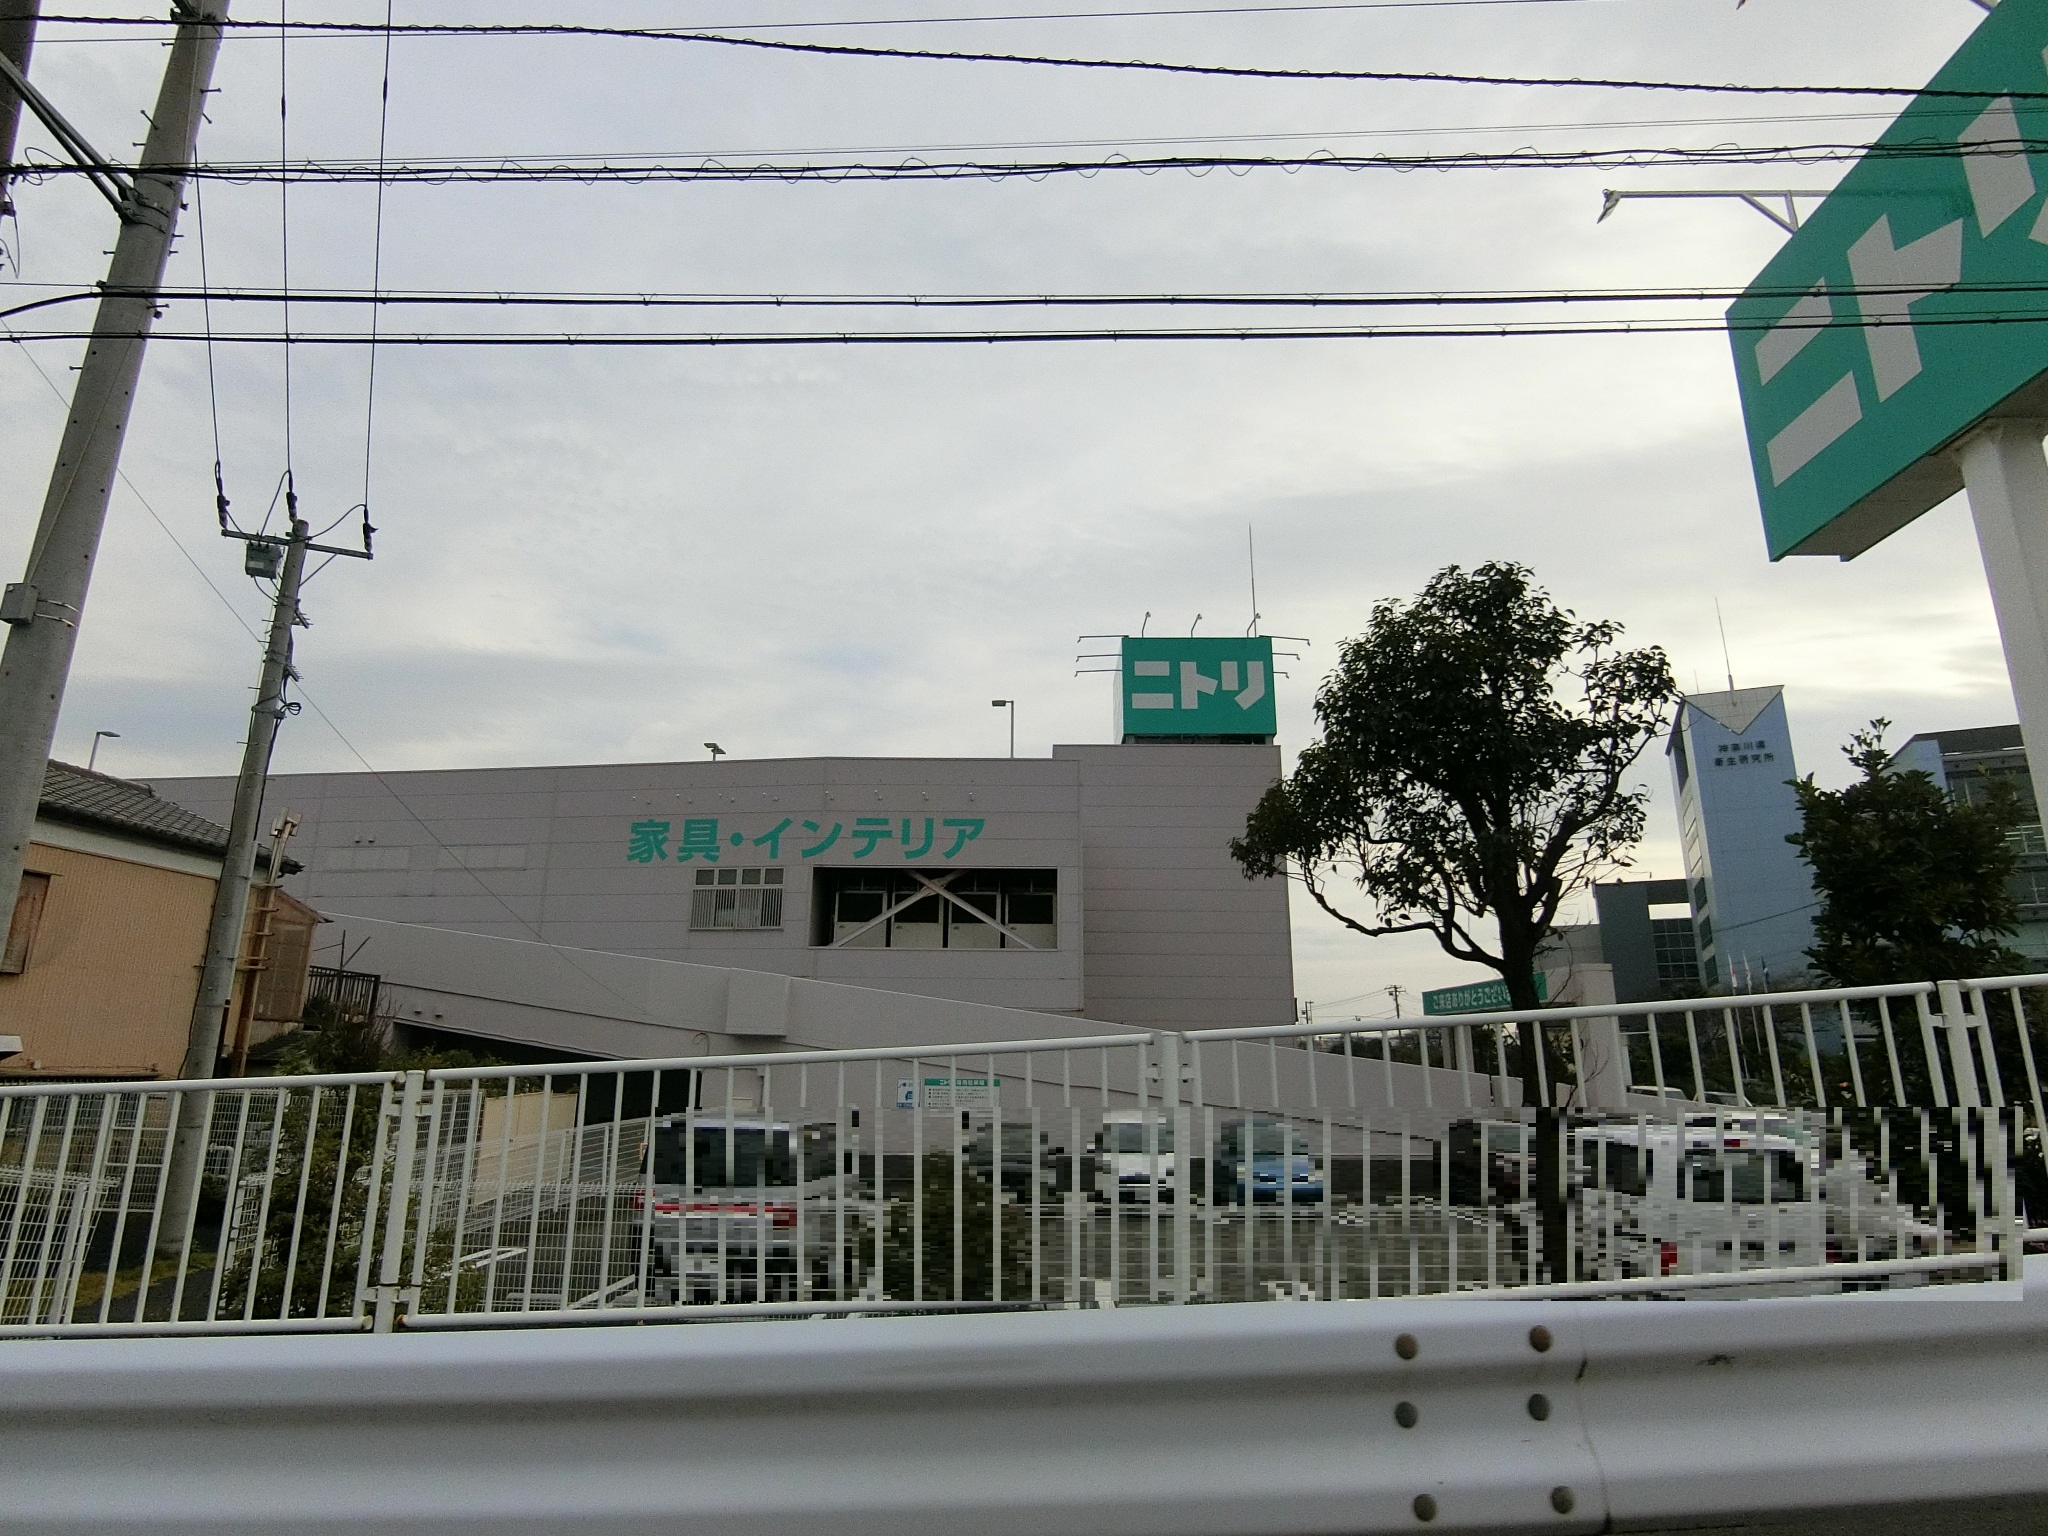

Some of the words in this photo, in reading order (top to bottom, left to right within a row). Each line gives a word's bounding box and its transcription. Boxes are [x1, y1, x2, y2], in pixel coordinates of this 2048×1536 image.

[1132, 660, 1265, 711] ニトリ
[627, 817, 985, 863] 家具・インテリア
